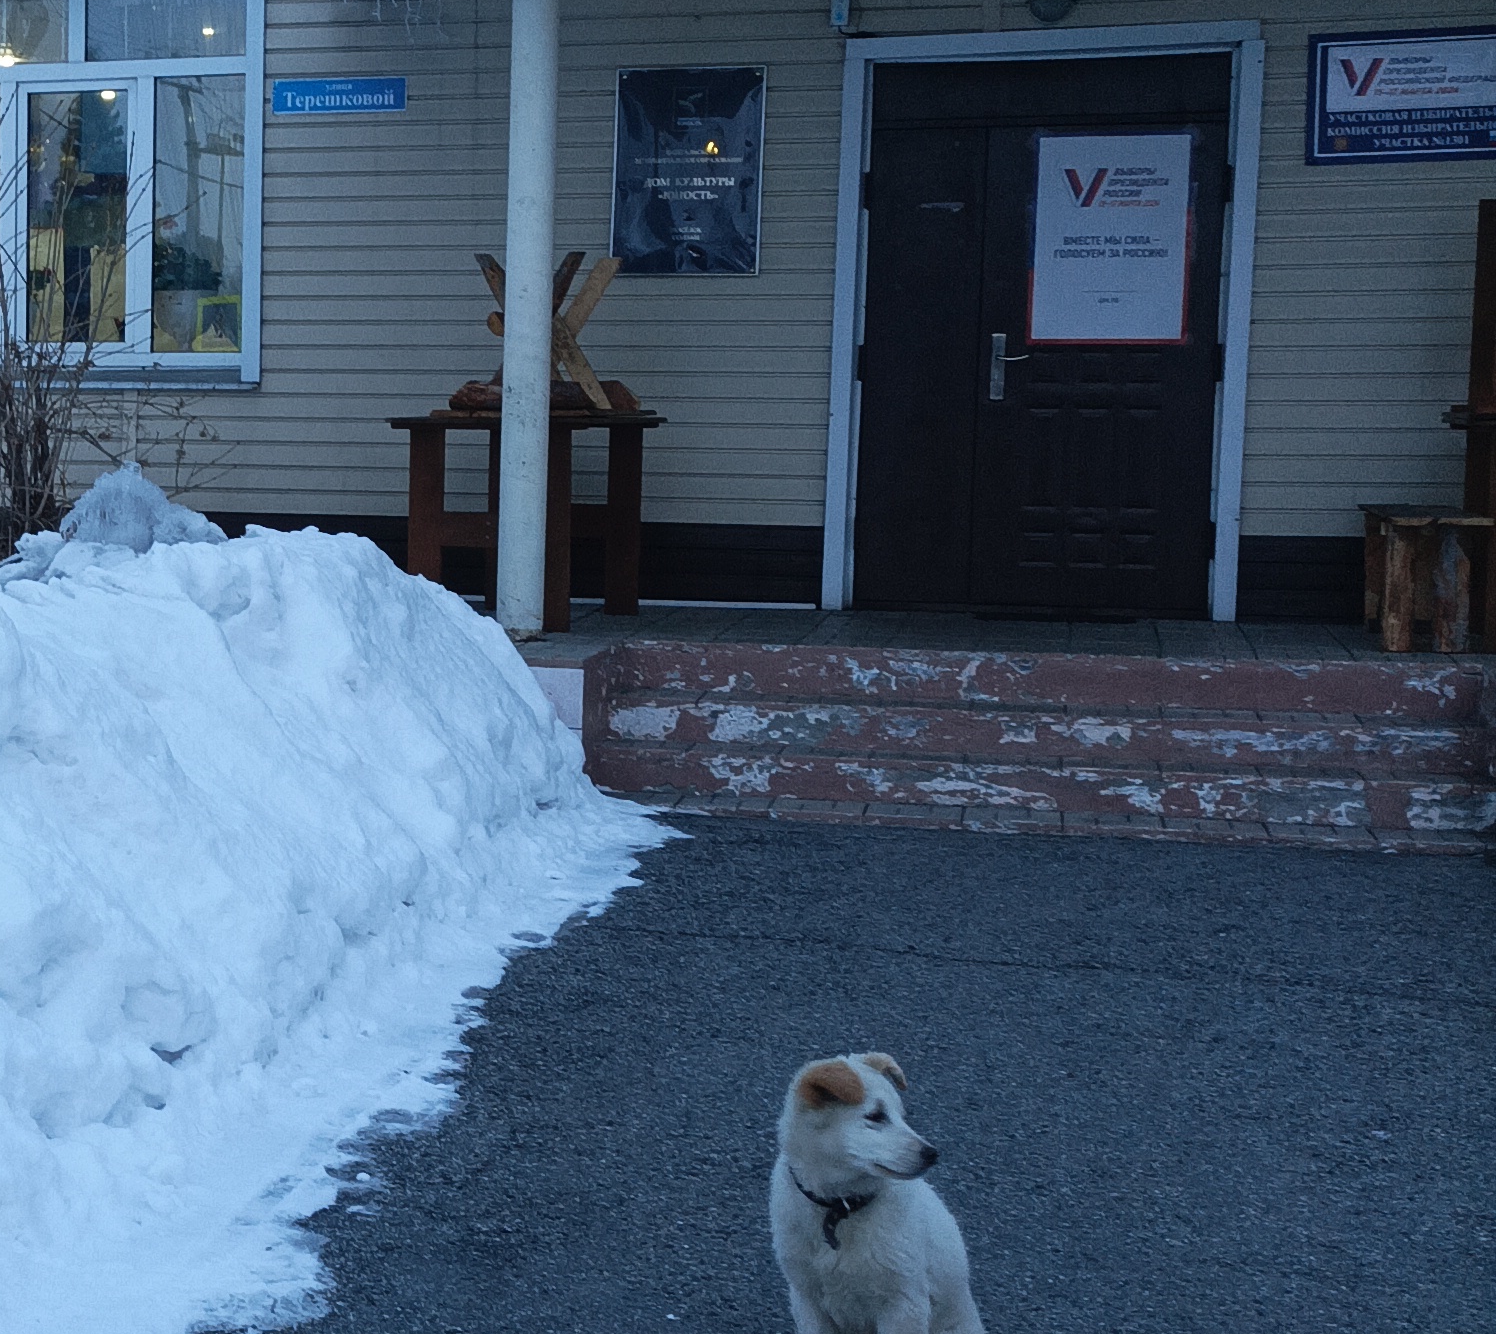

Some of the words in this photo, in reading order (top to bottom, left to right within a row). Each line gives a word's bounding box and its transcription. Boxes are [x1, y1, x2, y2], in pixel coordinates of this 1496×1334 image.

[283, 89, 395, 111] Терешковой
[1328, 111, 1408, 123] УЧАСТКОВАЯ
[1327, 124, 1399, 137] КОМИССИЯ
[1373, 137, 1429, 148] УЧАСТКА
[675, 177, 735, 187] КУЛЬТУРЫ
[1063, 236, 1101, 246] ВМЕСТЕ
[1104, 236, 1122, 245] МЫ
[1124, 235, 1150, 245] СИЛА
[1108, 249, 1120, 258] ЗА
